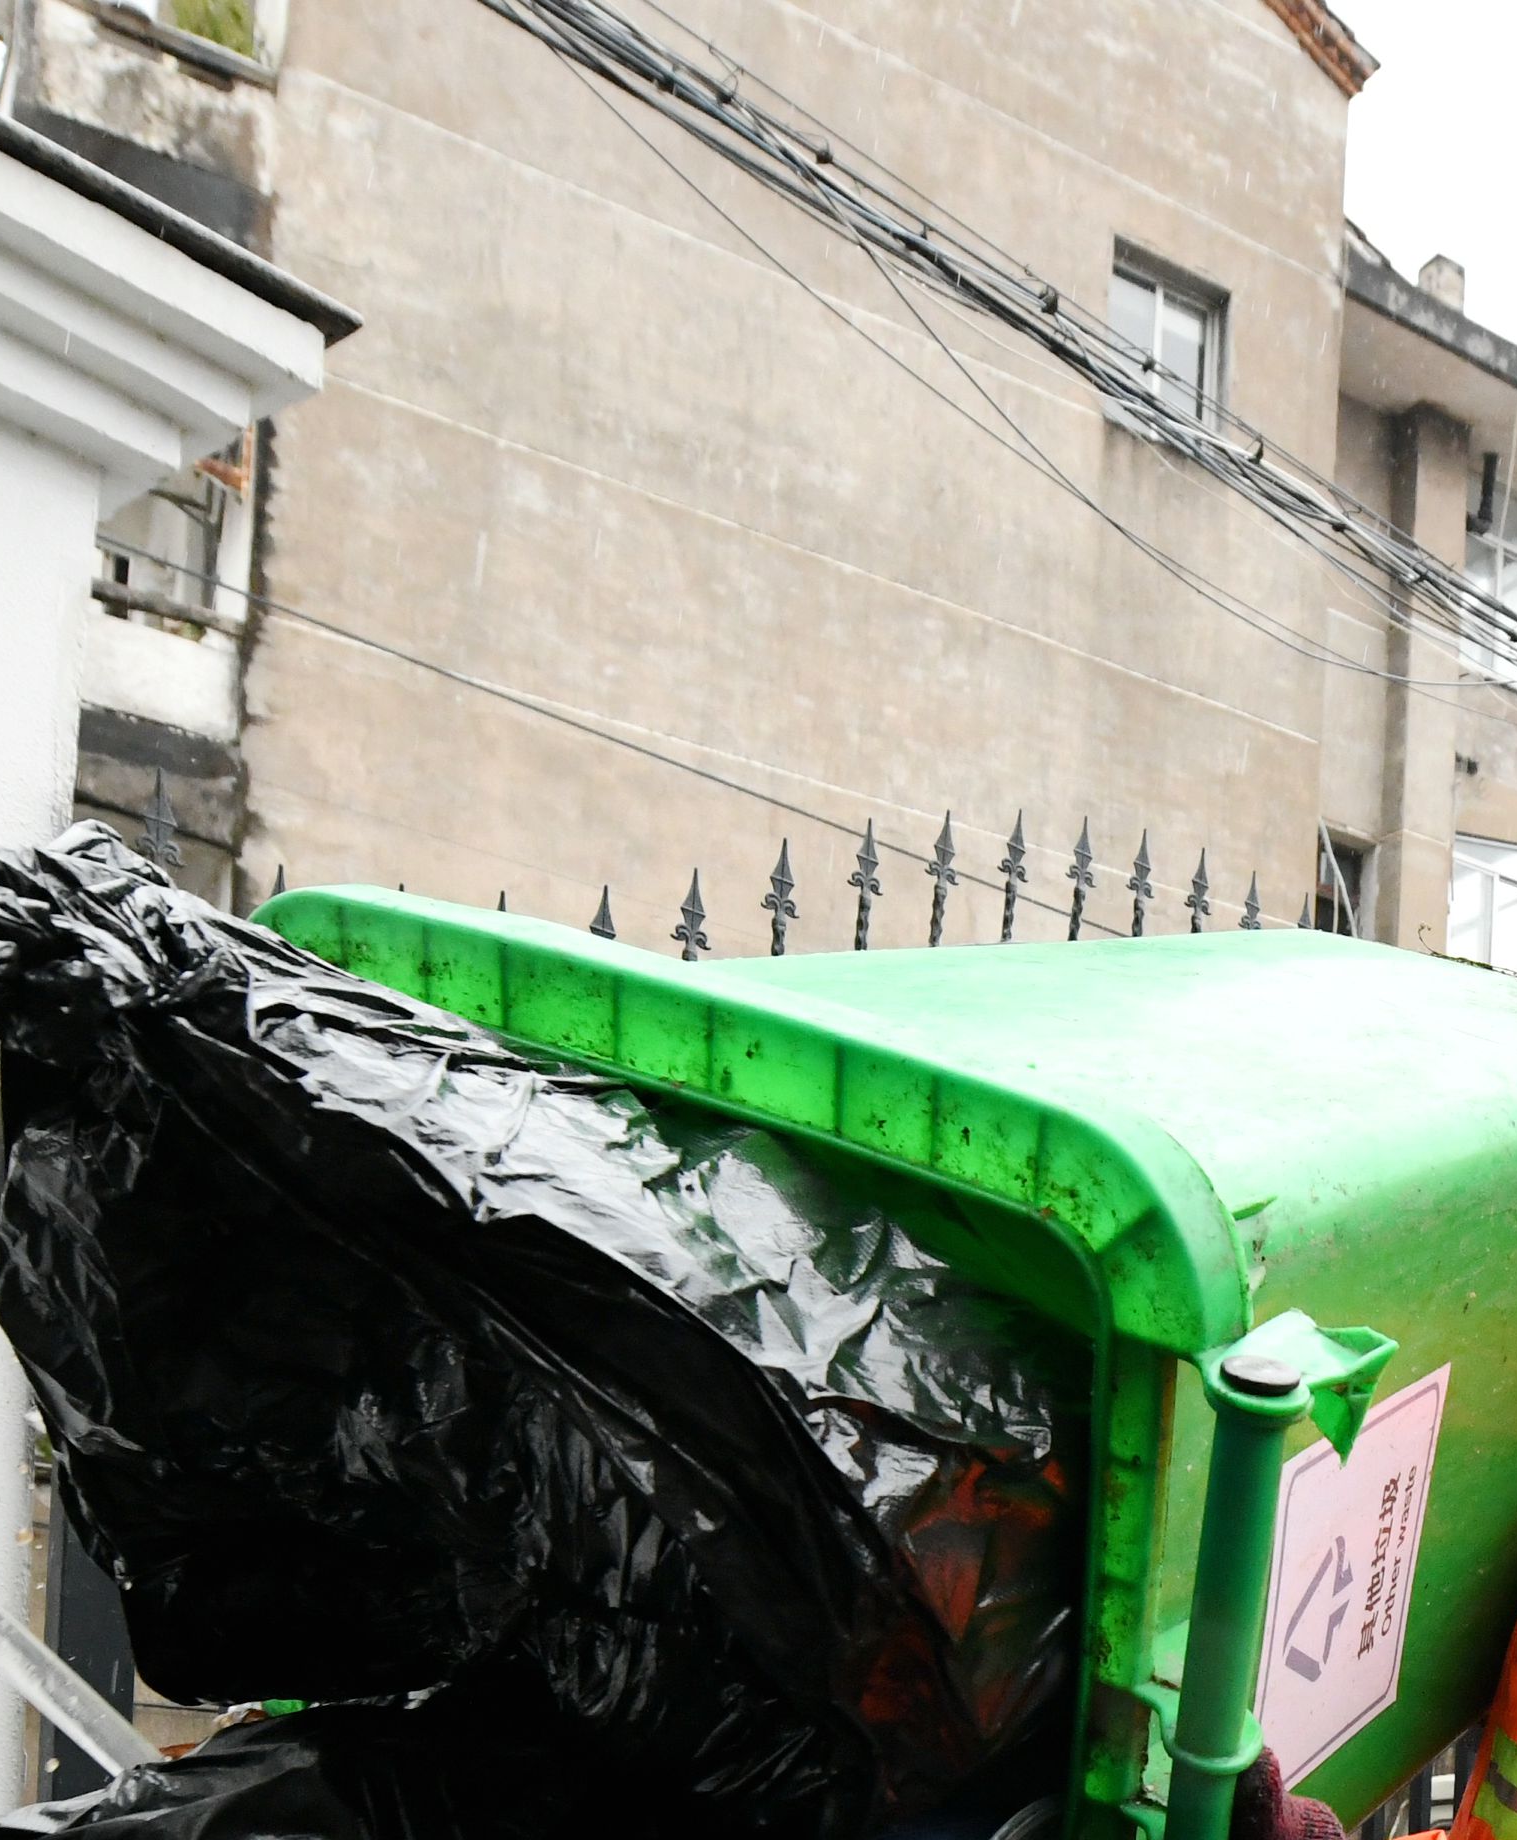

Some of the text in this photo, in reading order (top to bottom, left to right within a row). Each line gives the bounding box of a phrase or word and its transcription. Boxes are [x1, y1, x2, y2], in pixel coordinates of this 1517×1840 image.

[1357, 1472, 1401, 1660] 其他垃圾
[1381, 1465, 1417, 1636] Other waste
